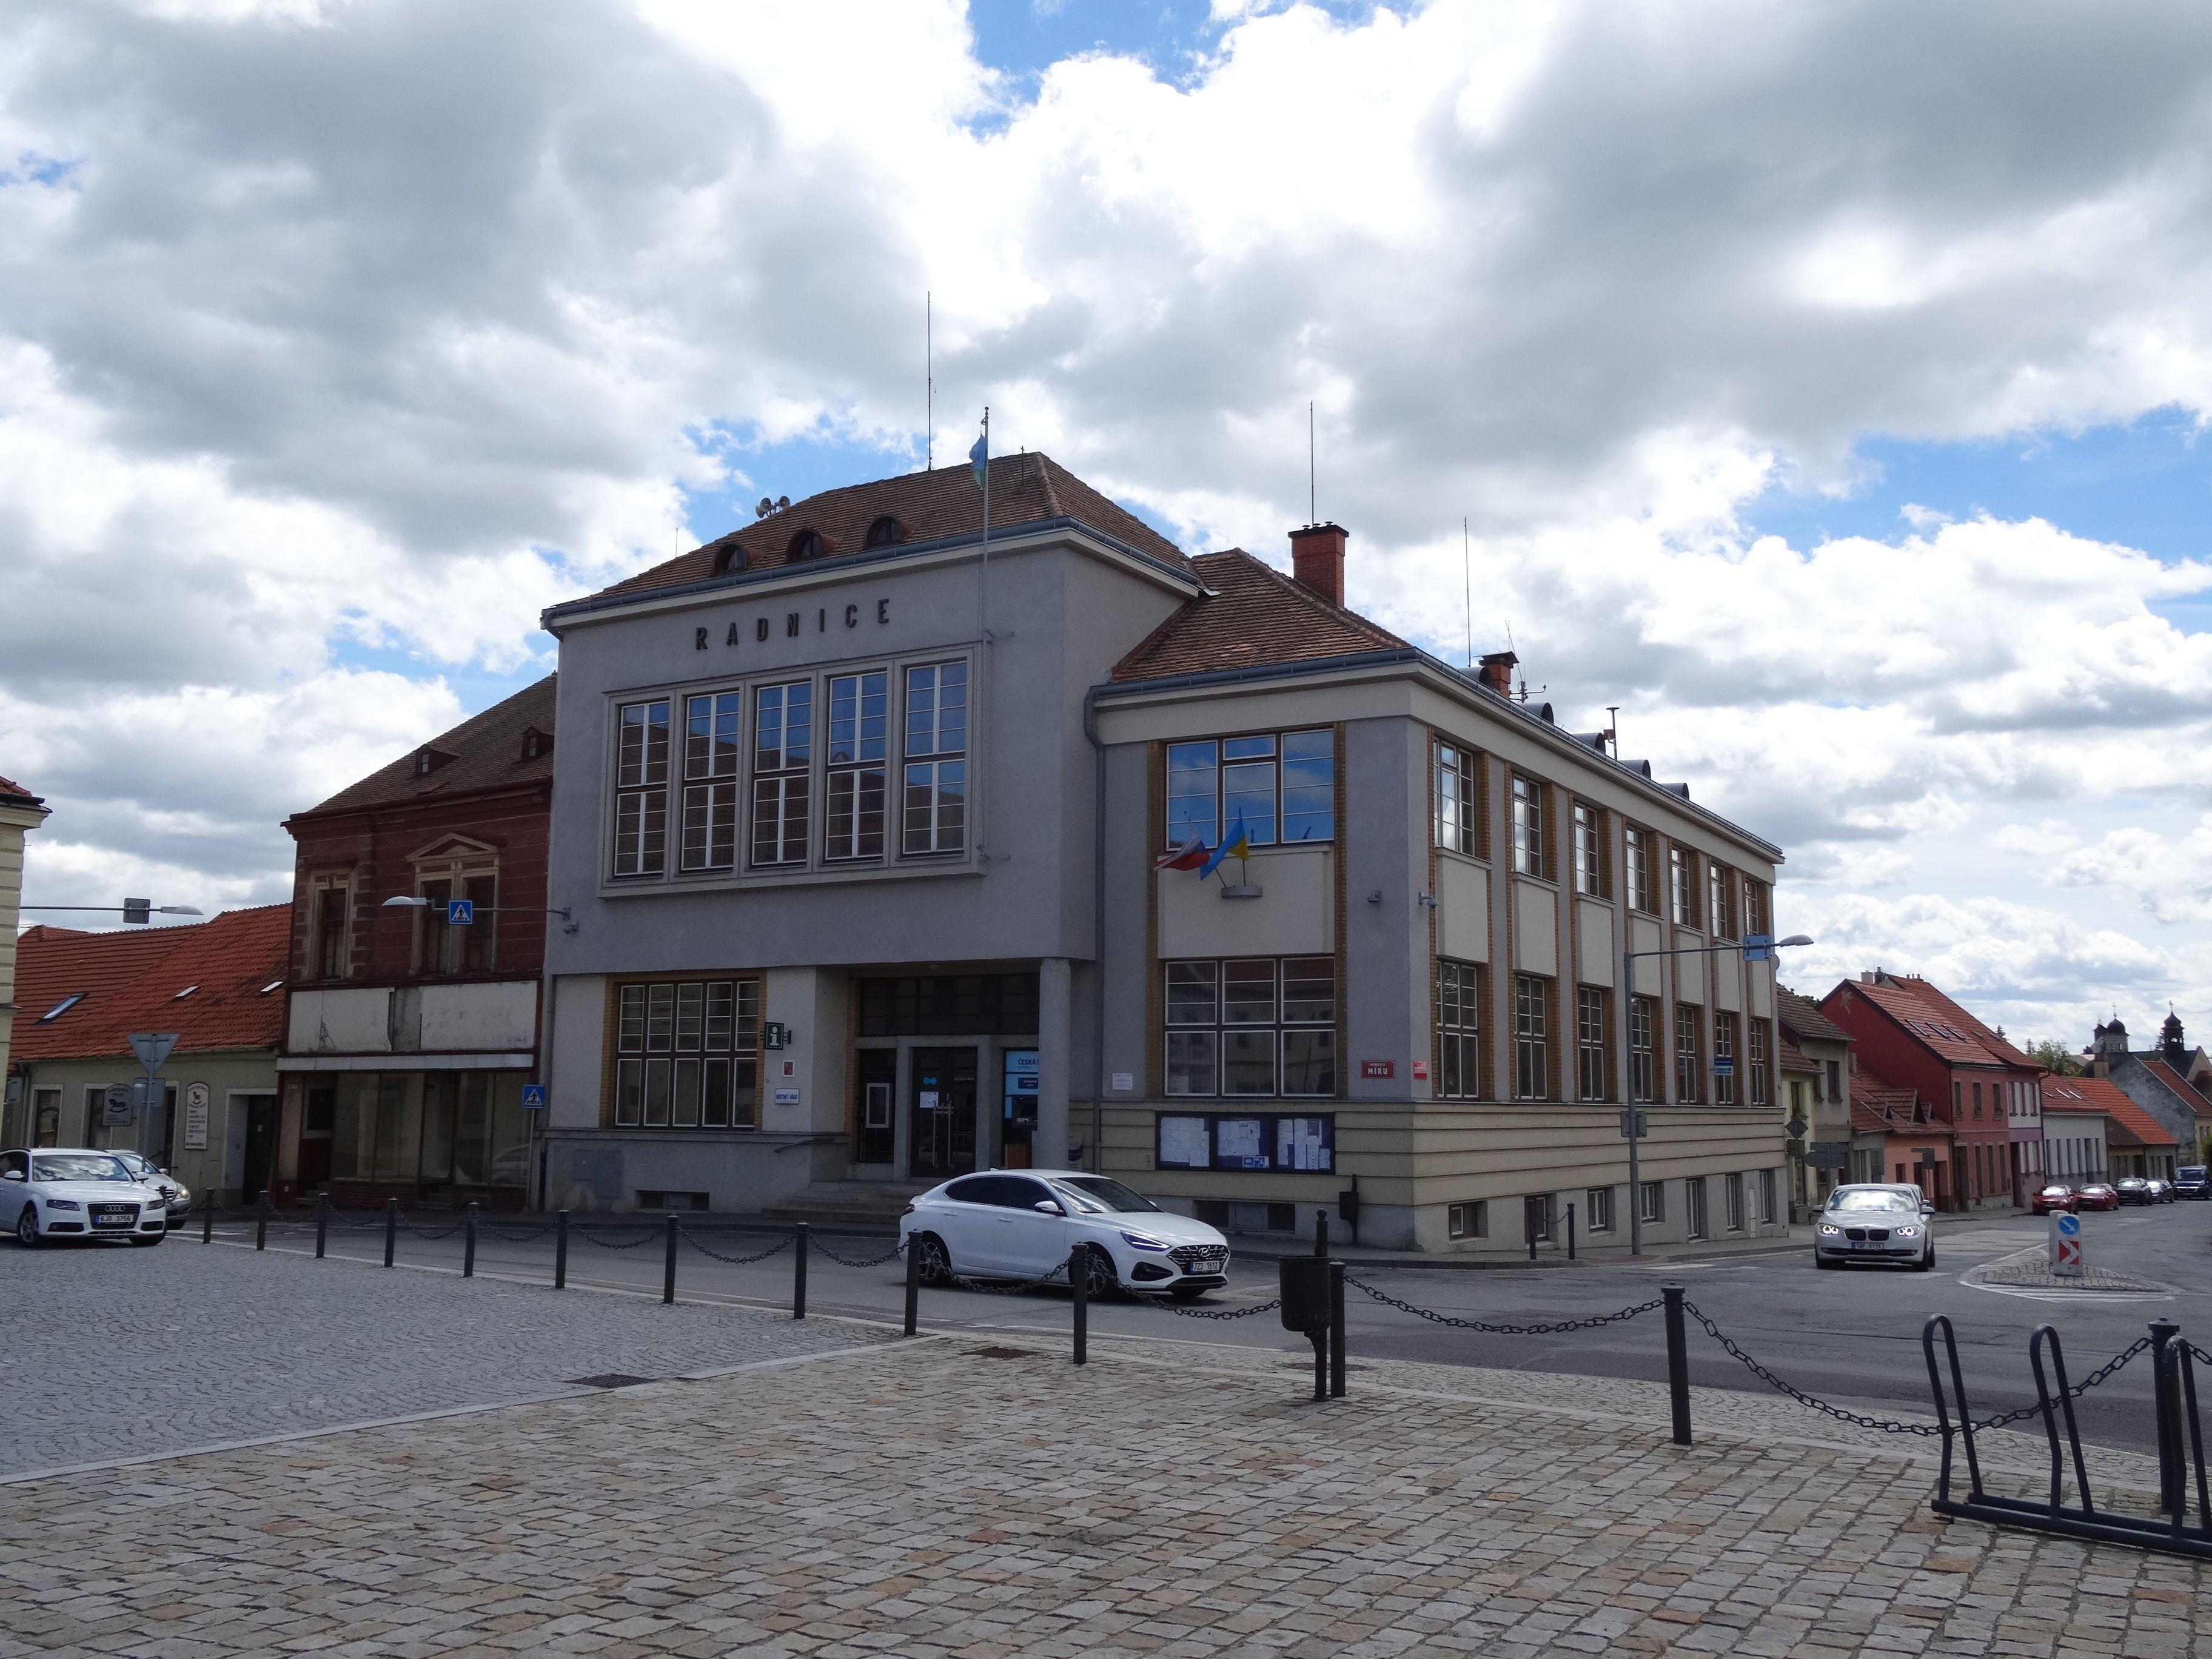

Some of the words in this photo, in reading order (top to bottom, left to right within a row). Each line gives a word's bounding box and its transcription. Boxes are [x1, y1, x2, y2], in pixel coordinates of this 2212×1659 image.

[695, 598, 890, 650] RADNICE
[1018, 1057, 1036, 1065] ČESKÁ
[1367, 1066, 1387, 1075] MÍRU
